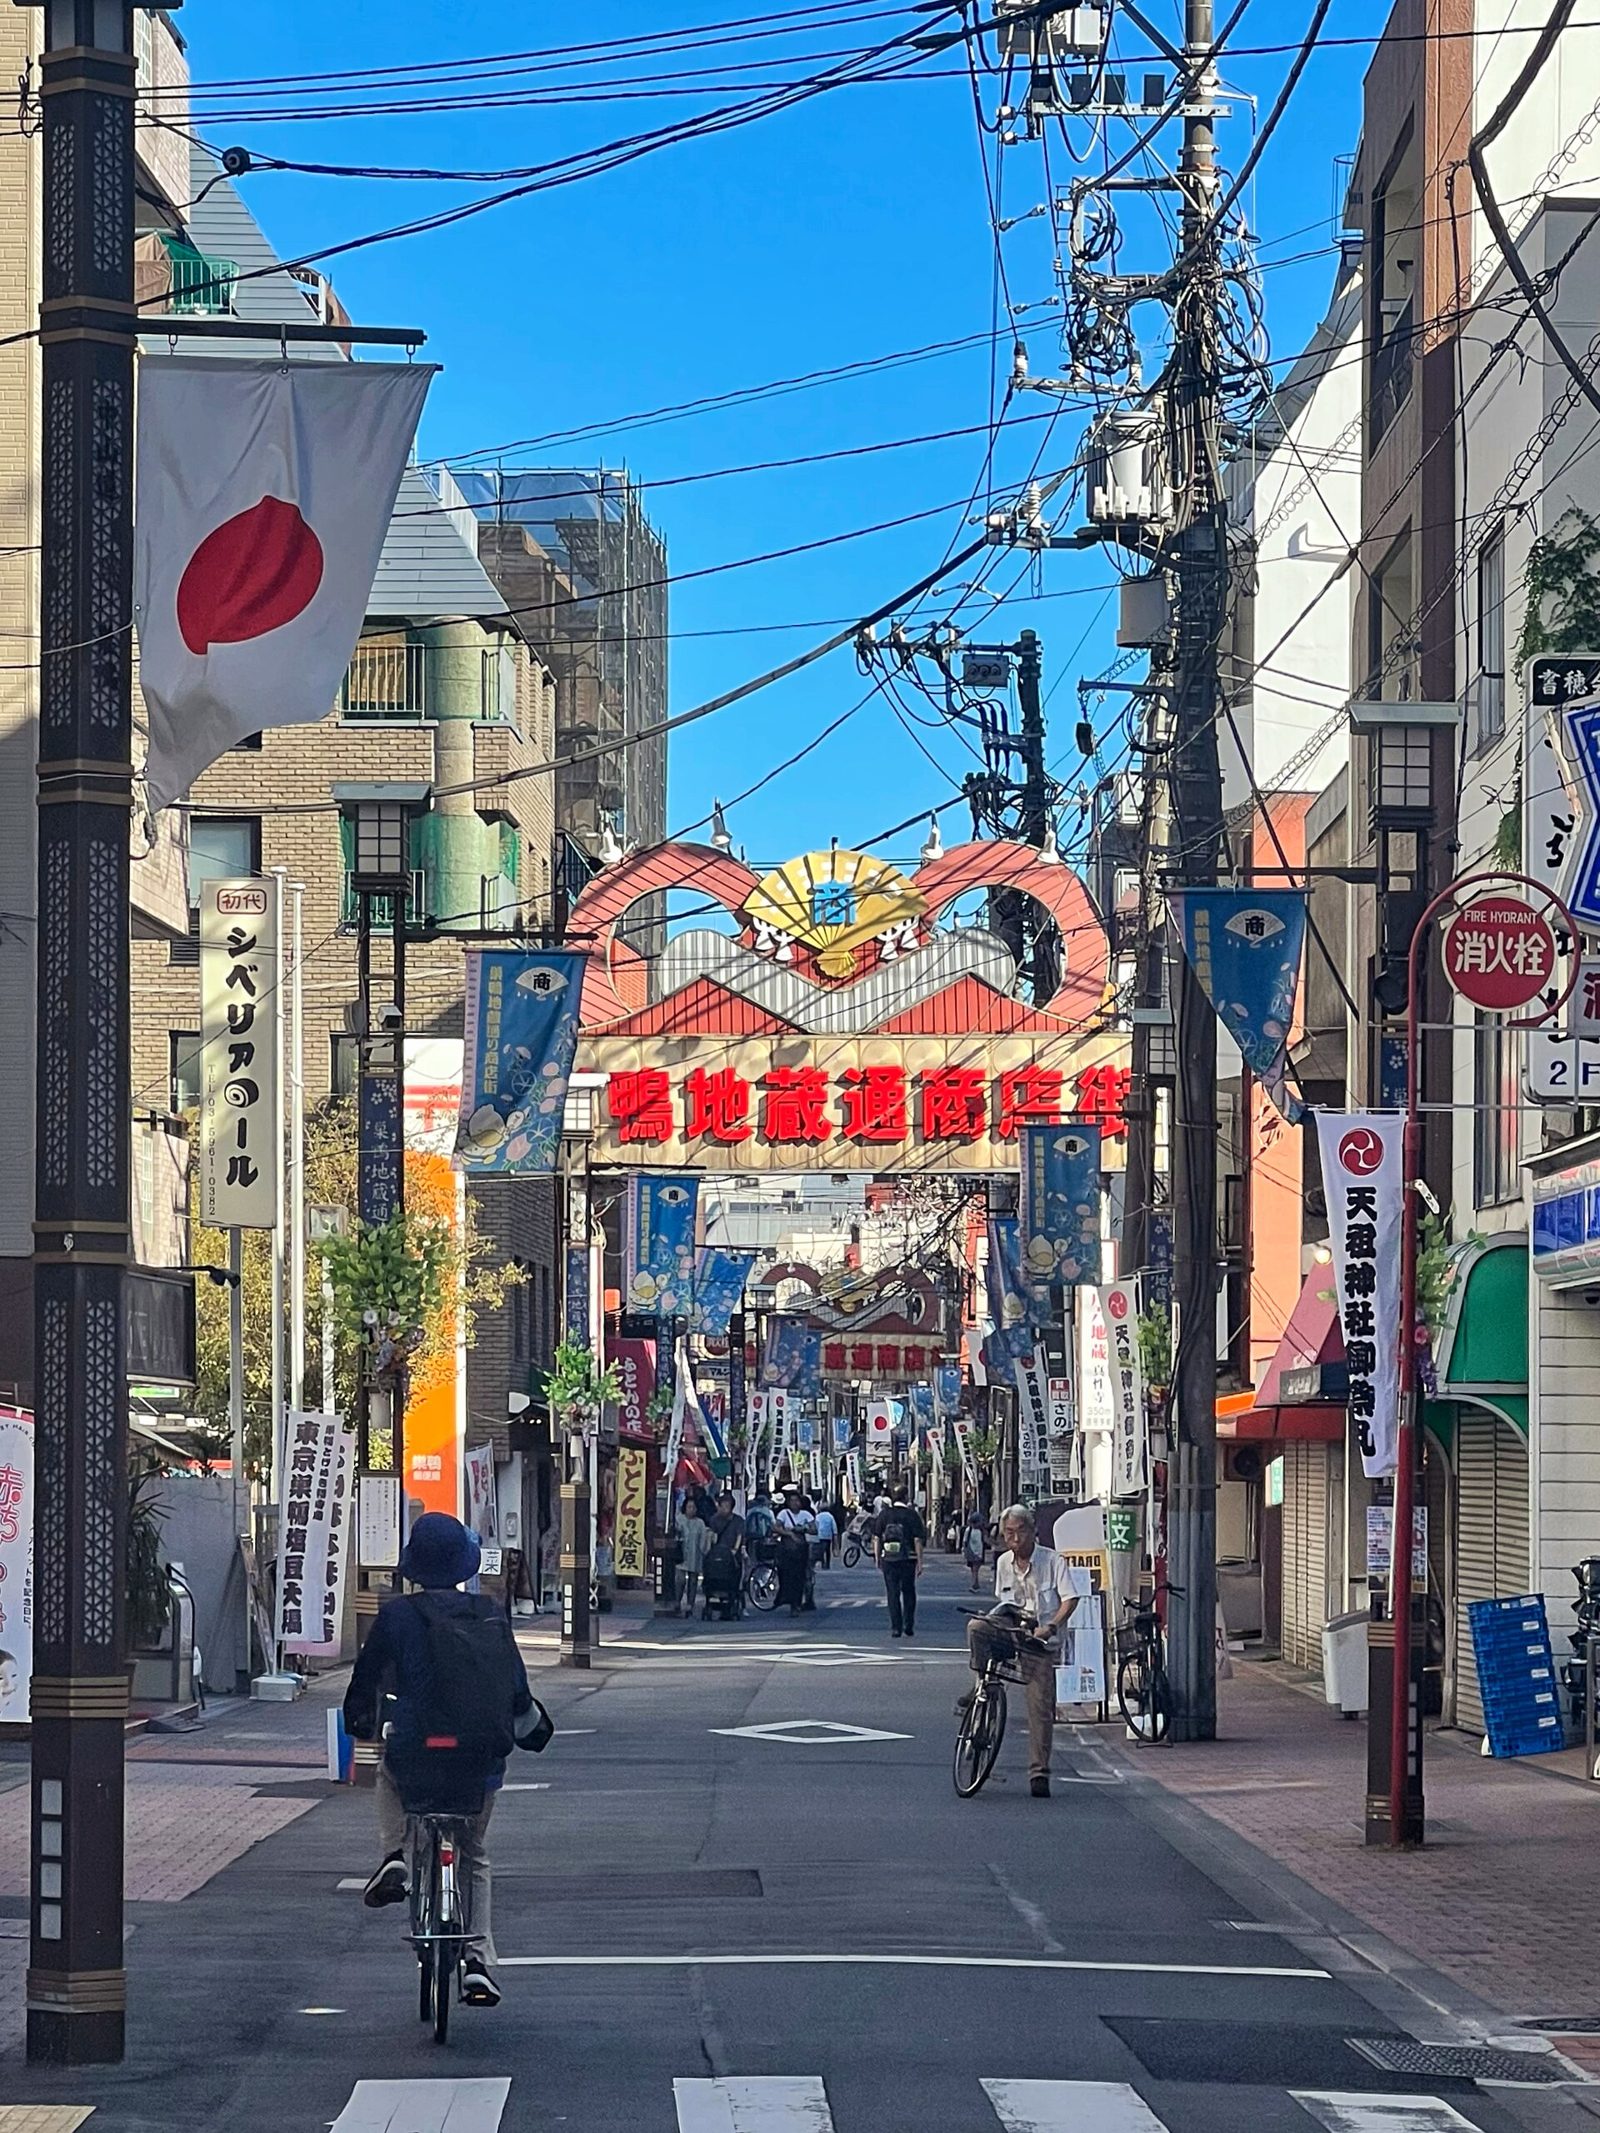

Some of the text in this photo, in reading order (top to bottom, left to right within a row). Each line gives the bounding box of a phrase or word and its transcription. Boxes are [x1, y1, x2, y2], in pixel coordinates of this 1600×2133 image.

[221, 893, 262, 910] 初代
[1464, 910, 1537, 924] FIRE HYDRANT
[1455, 930, 1547, 975] 消火栓
[577, 1065, 1132, 1143] 鴨地蔵通商店街
[281, 1420, 321, 1635] 東京巣鴨塩豆大福
